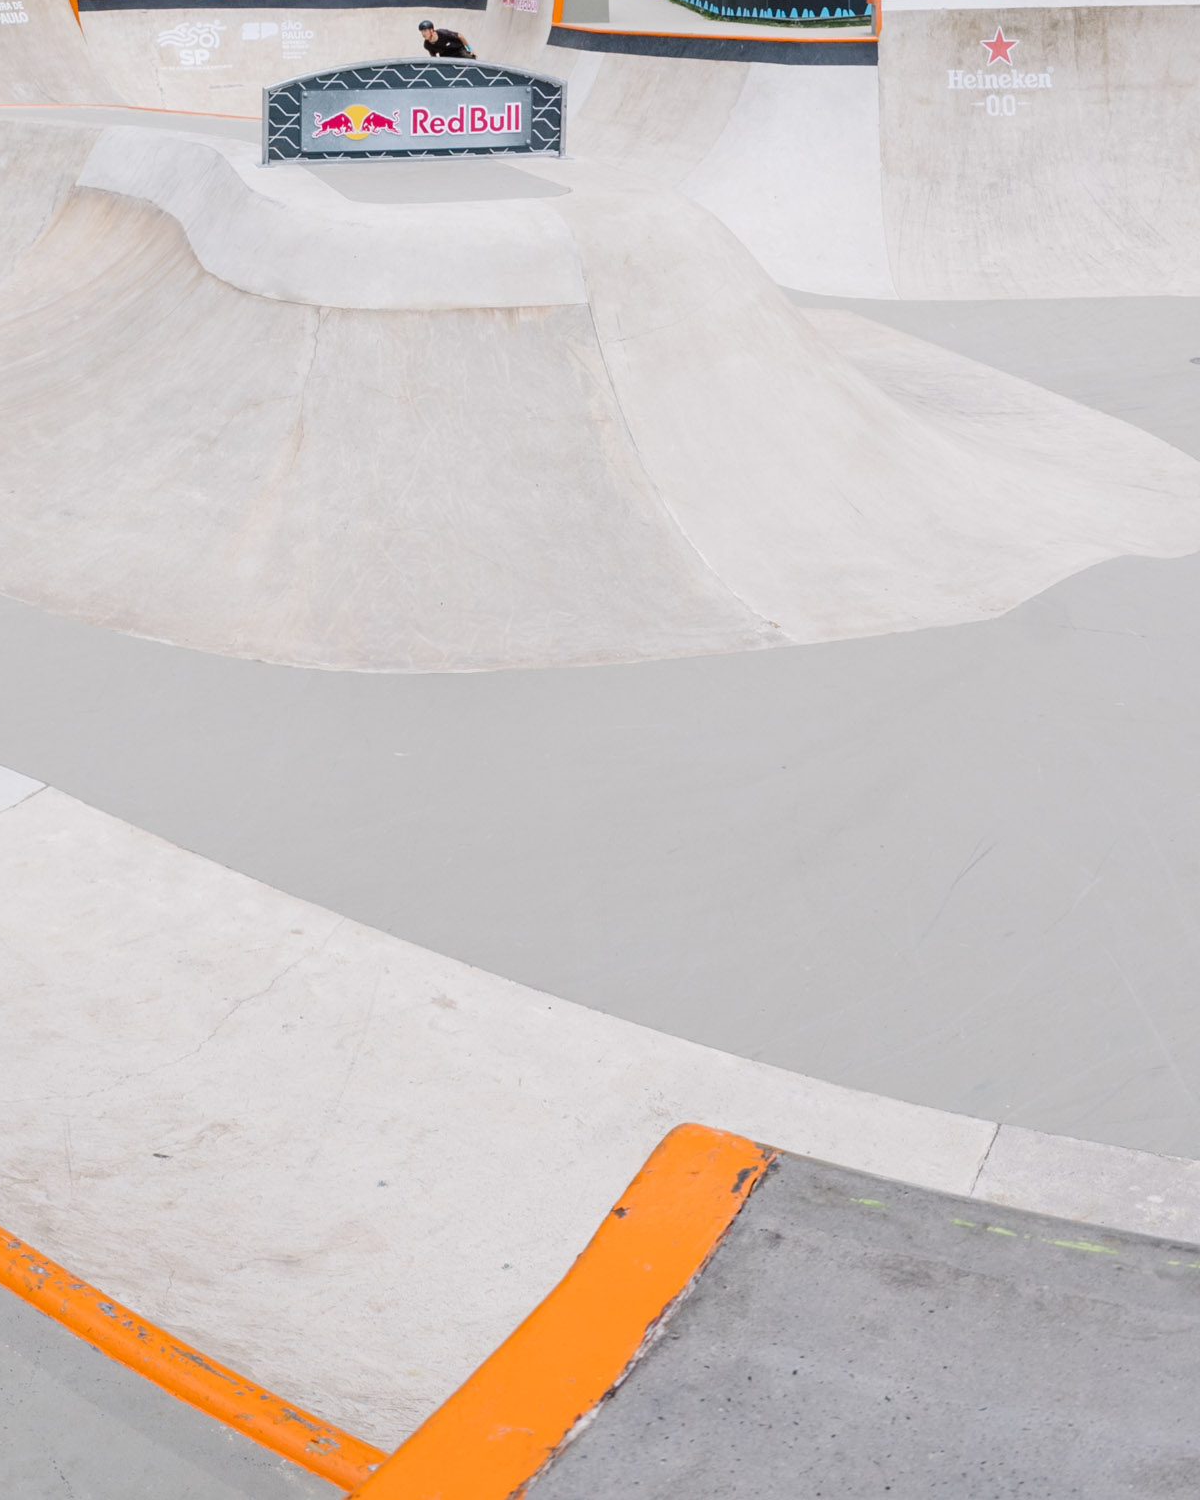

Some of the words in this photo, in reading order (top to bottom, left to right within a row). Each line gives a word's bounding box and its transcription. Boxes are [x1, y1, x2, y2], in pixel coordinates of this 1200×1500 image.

[12, 1, 24, 10] DE
[281, 20, 302, 30] SÃO
[281, 30, 314, 39] PAULO
[179, 50, 210, 66] SP
[946, 68, 1053, 89] Heineken
[411, 104, 467, 136] Red
[469, 102, 521, 134] Bull
